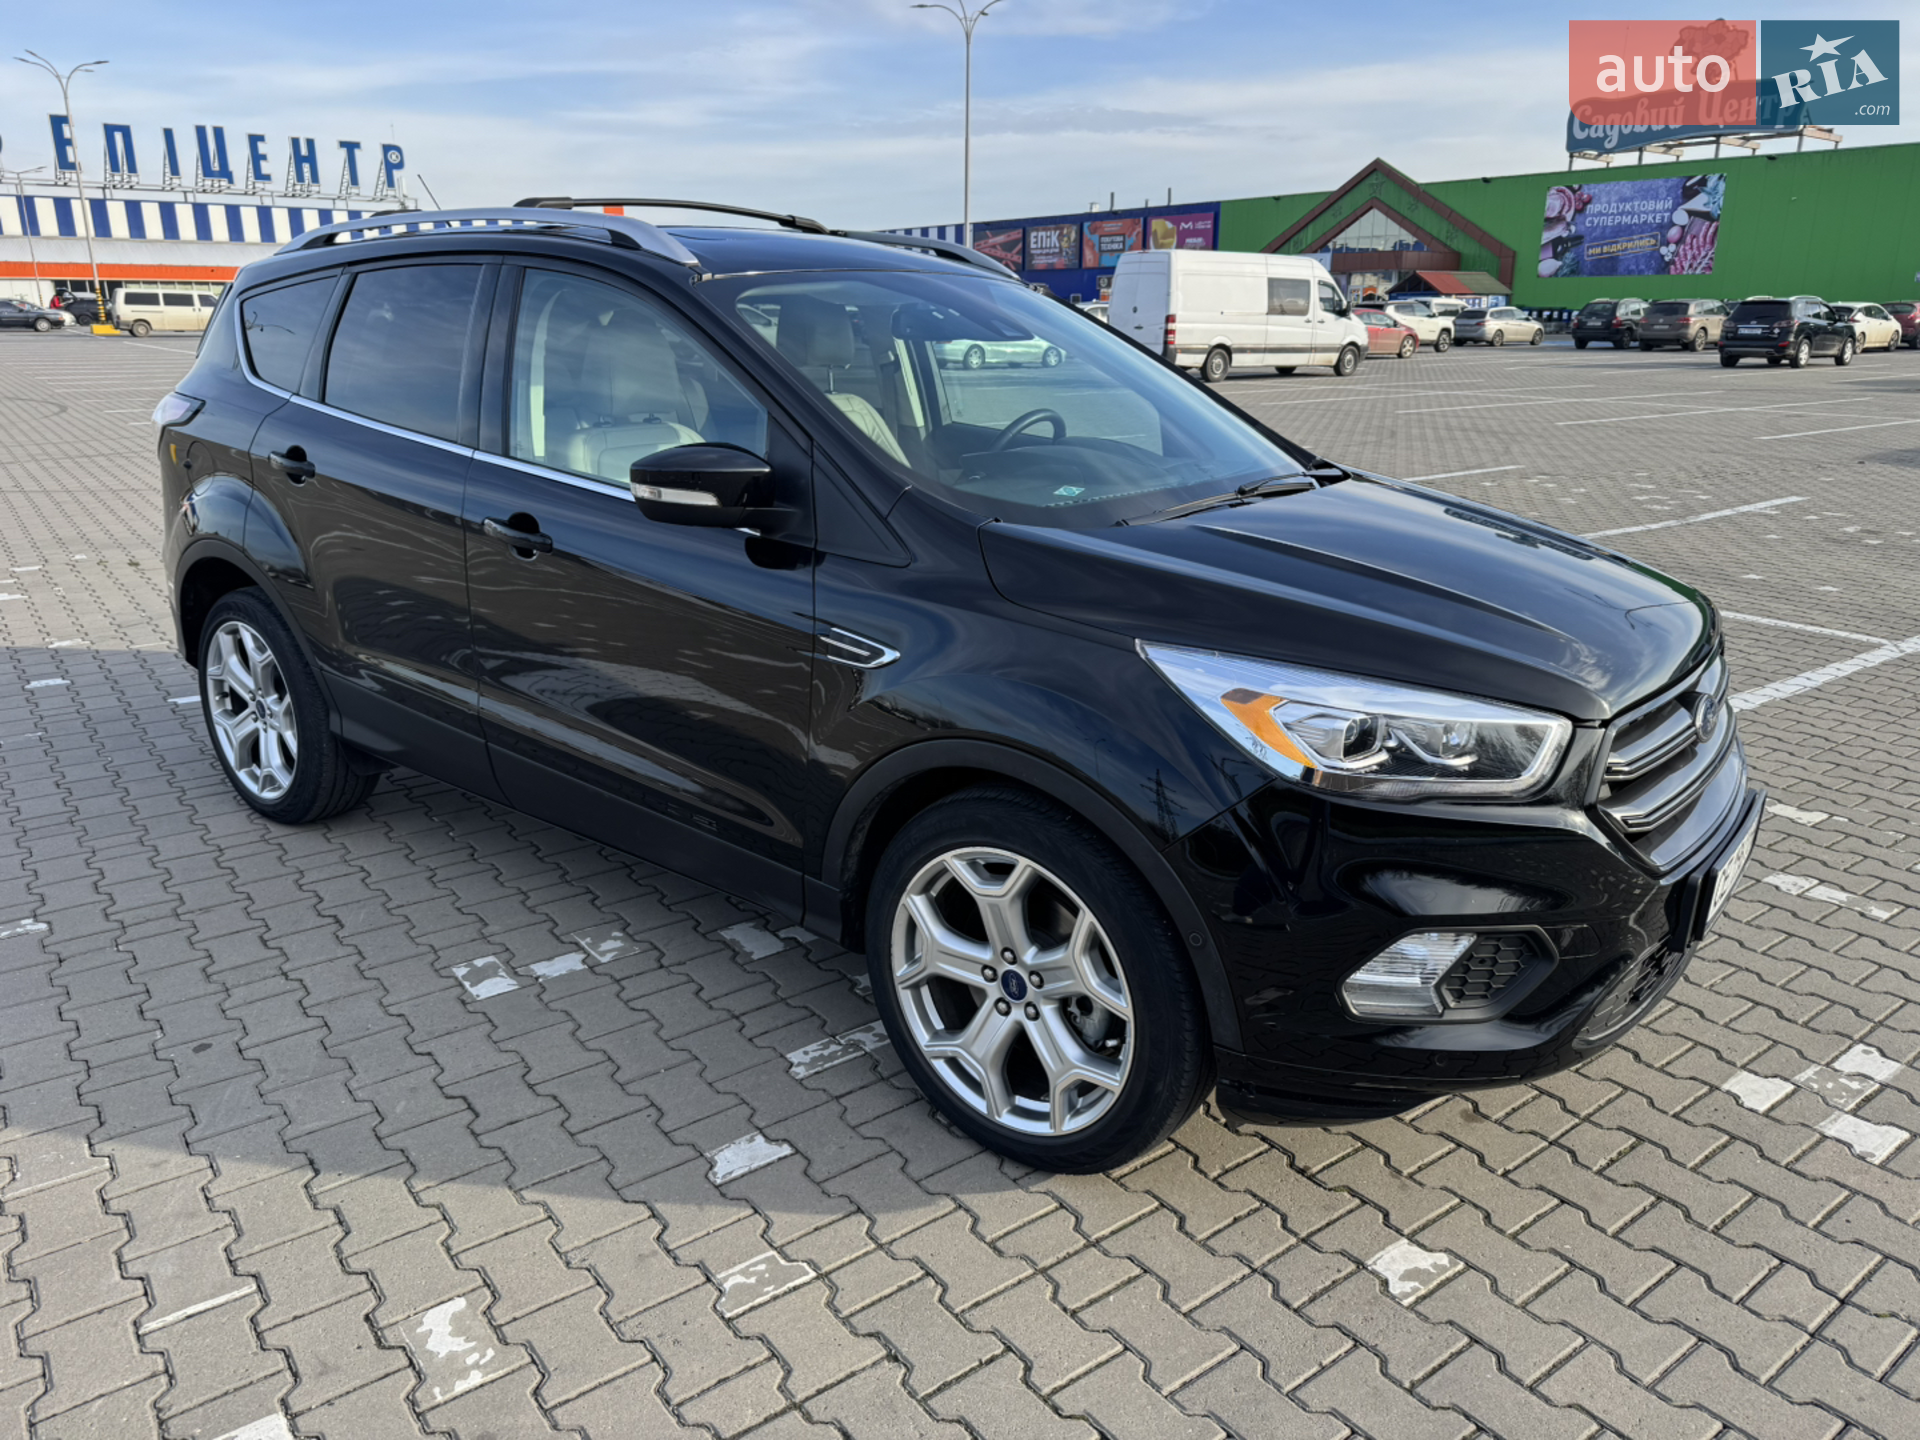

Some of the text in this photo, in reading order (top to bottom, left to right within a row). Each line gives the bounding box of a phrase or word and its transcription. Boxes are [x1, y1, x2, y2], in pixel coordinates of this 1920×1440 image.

[1572, 96, 1686, 149] Садовий
[48, 114, 405, 189] ЕПІЦЕНТР
[1586, 196, 1673, 214] ПРОДУКТОВИЙ
[1585, 212, 1671, 227] СУПЕРМАРКЕТ
[1602, 238, 1657, 255] ВІДКРИЛИСЬ
